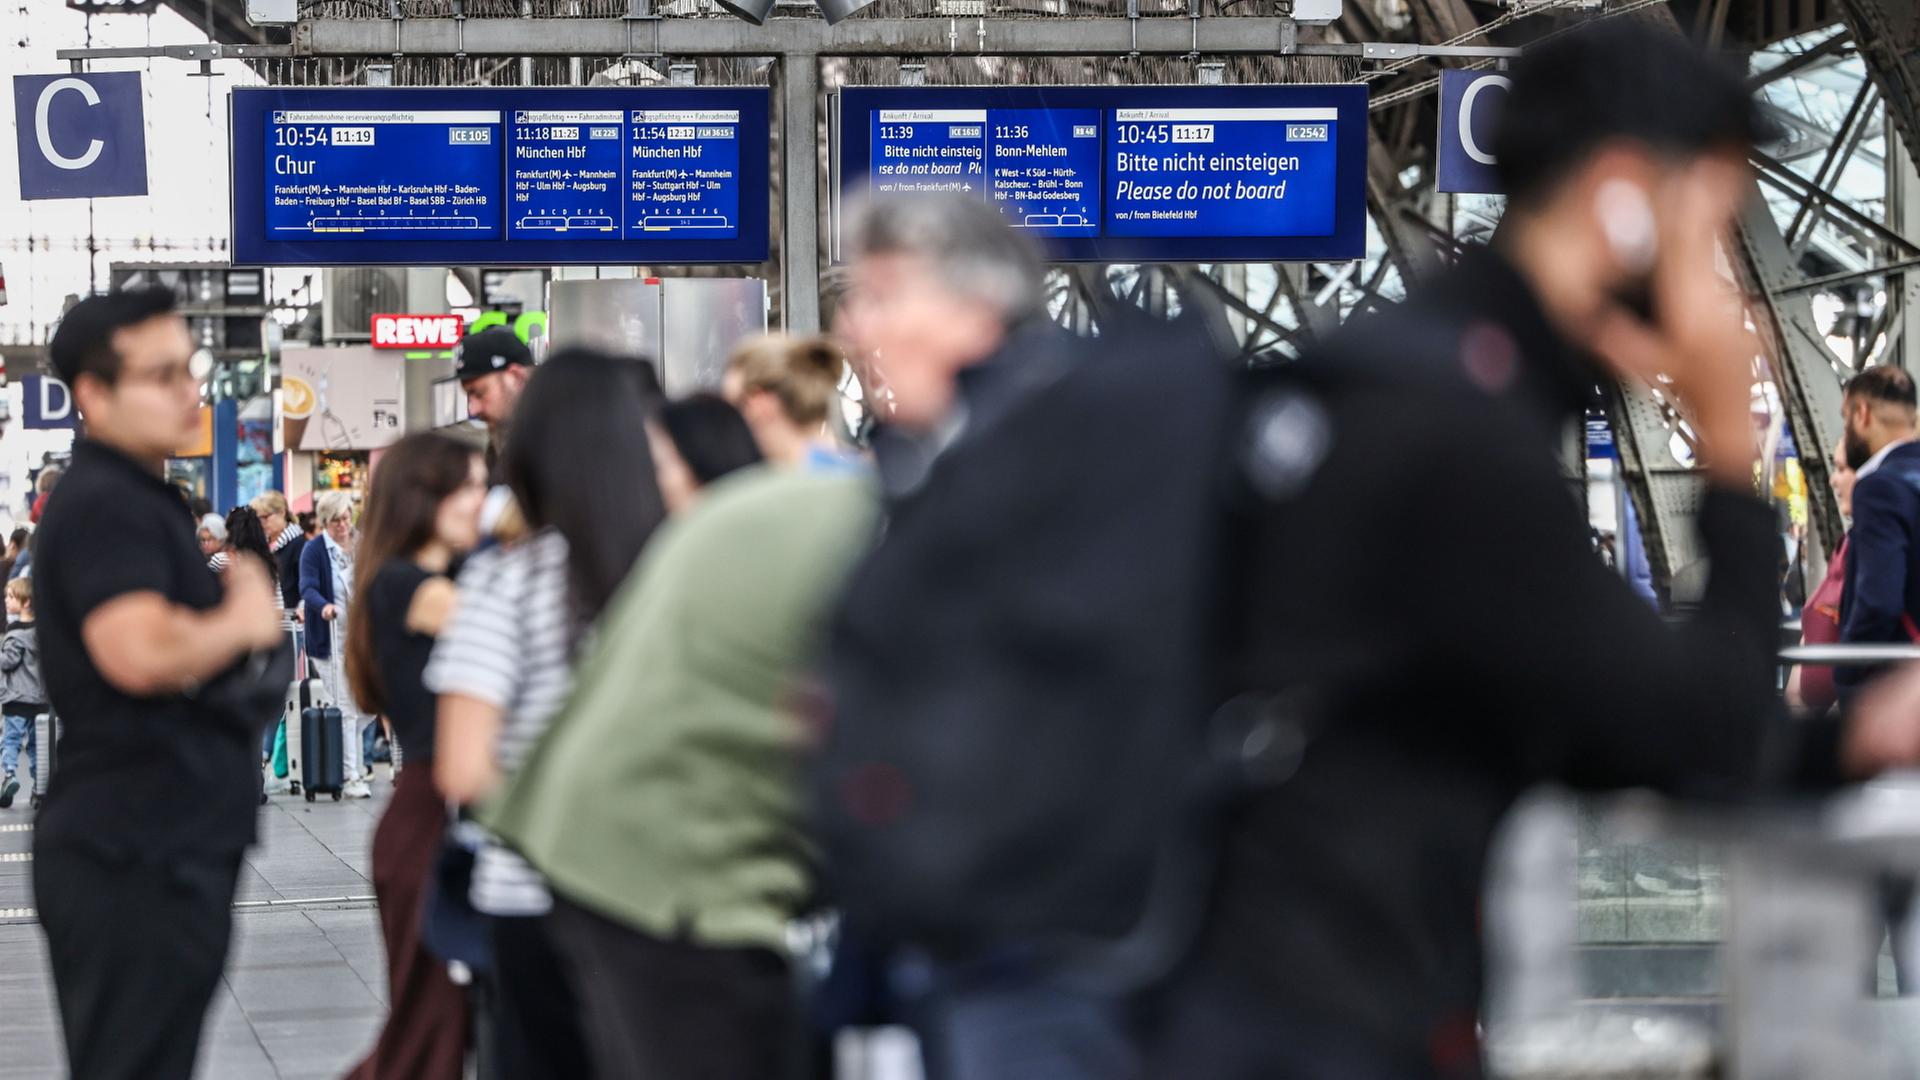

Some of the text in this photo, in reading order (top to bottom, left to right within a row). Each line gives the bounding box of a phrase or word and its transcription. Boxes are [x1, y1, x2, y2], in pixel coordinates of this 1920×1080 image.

[882, 112, 907, 120] Ankunft
[913, 112, 933, 120] Arrival
[1119, 111, 1143, 119] Ankunft
[1149, 111, 1170, 119] Arrival
[1459, 75, 1512, 165] C
[35, 77, 104, 170] C
[275, 127, 371, 146] 10:54 11:19
[452, 131, 488, 141] ICE 105
[516, 128, 578, 140] 11:18 11:25
[592, 129, 601, 137] ICE
[633, 128, 693, 140] 11:54 12:12
[711, 129, 728, 137] 3615
[880, 126, 913, 139] 11:39
[951, 128, 961, 136] ICE
[995, 125, 1028, 139] 11:36
[1118, 125, 1210, 144] 10:45 11:17
[1288, 127, 1325, 139] IC 2542
[516, 145, 586, 159] München Hbf
[633, 145, 702, 159] München Hbf
[885, 145, 982, 159] Bitte nicht einsteig
[995, 145, 1067, 157] Bonn-Mehlem
[275, 154, 316, 175] Chur
[895, 162, 909, 175] do
[912, 163, 929, 175] not
[931, 162, 961, 175] board
[1117, 152, 1299, 176] Bitte nicht einsteigen
[579, 170, 616, 179] Mannheim
[695, 170, 732, 178] Mannheim
[995, 168, 1076, 177] K West K Süd Hürth-
[339, 185, 376, 194] Mannheim
[378, 185, 391, 194] Hbf
[398, 184, 433, 194] Karlsruhe
[434, 184, 447, 194] Hbf
[455, 184, 480, 194] Baden-
[516, 182, 607, 192] Hbf Ulm Hbf Augsburg
[633, 181, 721, 192] Hbf Stuttgart Hbf Ulm
[880, 184, 893, 192] von
[900, 183, 915, 192] from
[995, 179, 1083, 189] Kalscheur. Brühl Bonn
[1116, 179, 1286, 200] Please do not board
[275, 196, 487, 207] Baden Freiburg Hbf Basel Bad Bf Basel SBB Zürich HB
[516, 193, 529, 201] Hbf
[633, 193, 701, 203] Hbf Augsburg Hbf
[995, 191, 1080, 201] Hbf BN-Bad Godesberg
[1134, 210, 1150, 219] from
[1152, 210, 1183, 219] Bielefeld
[1184, 210, 1197, 219] Hbf
[376, 318, 460, 344] REWE
[40, 375, 71, 420] D
